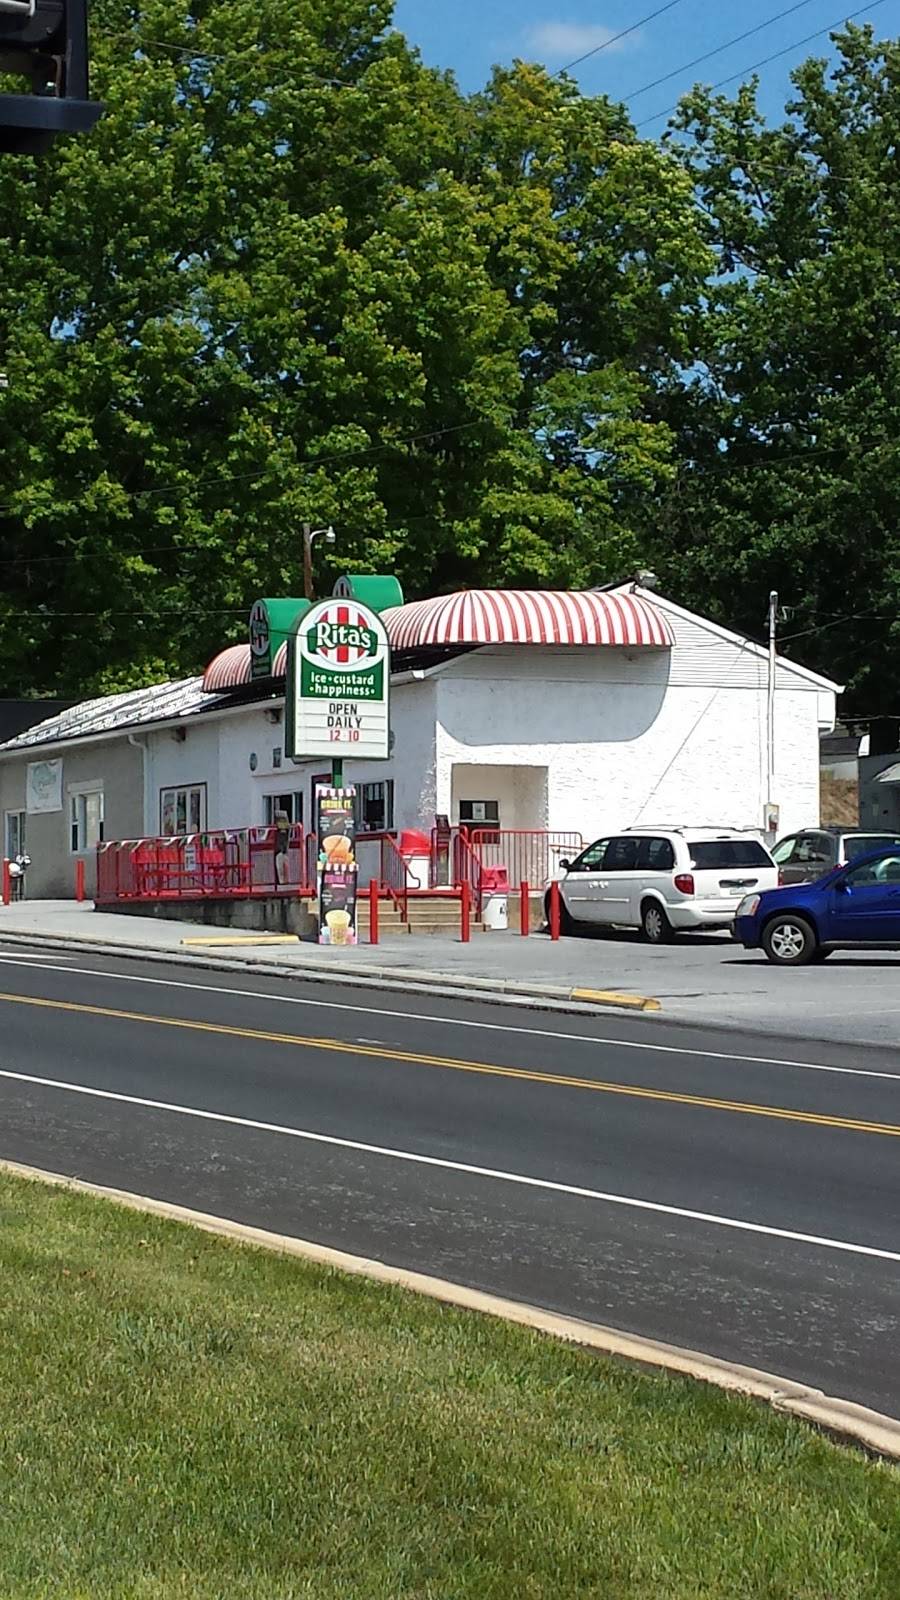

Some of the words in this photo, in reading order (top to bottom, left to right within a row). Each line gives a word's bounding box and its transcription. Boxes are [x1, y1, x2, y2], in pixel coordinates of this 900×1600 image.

[317, 623, 371, 648] Rita's
[329, 703, 358, 715] OPEN
[327, 716, 362, 728] DAILY
